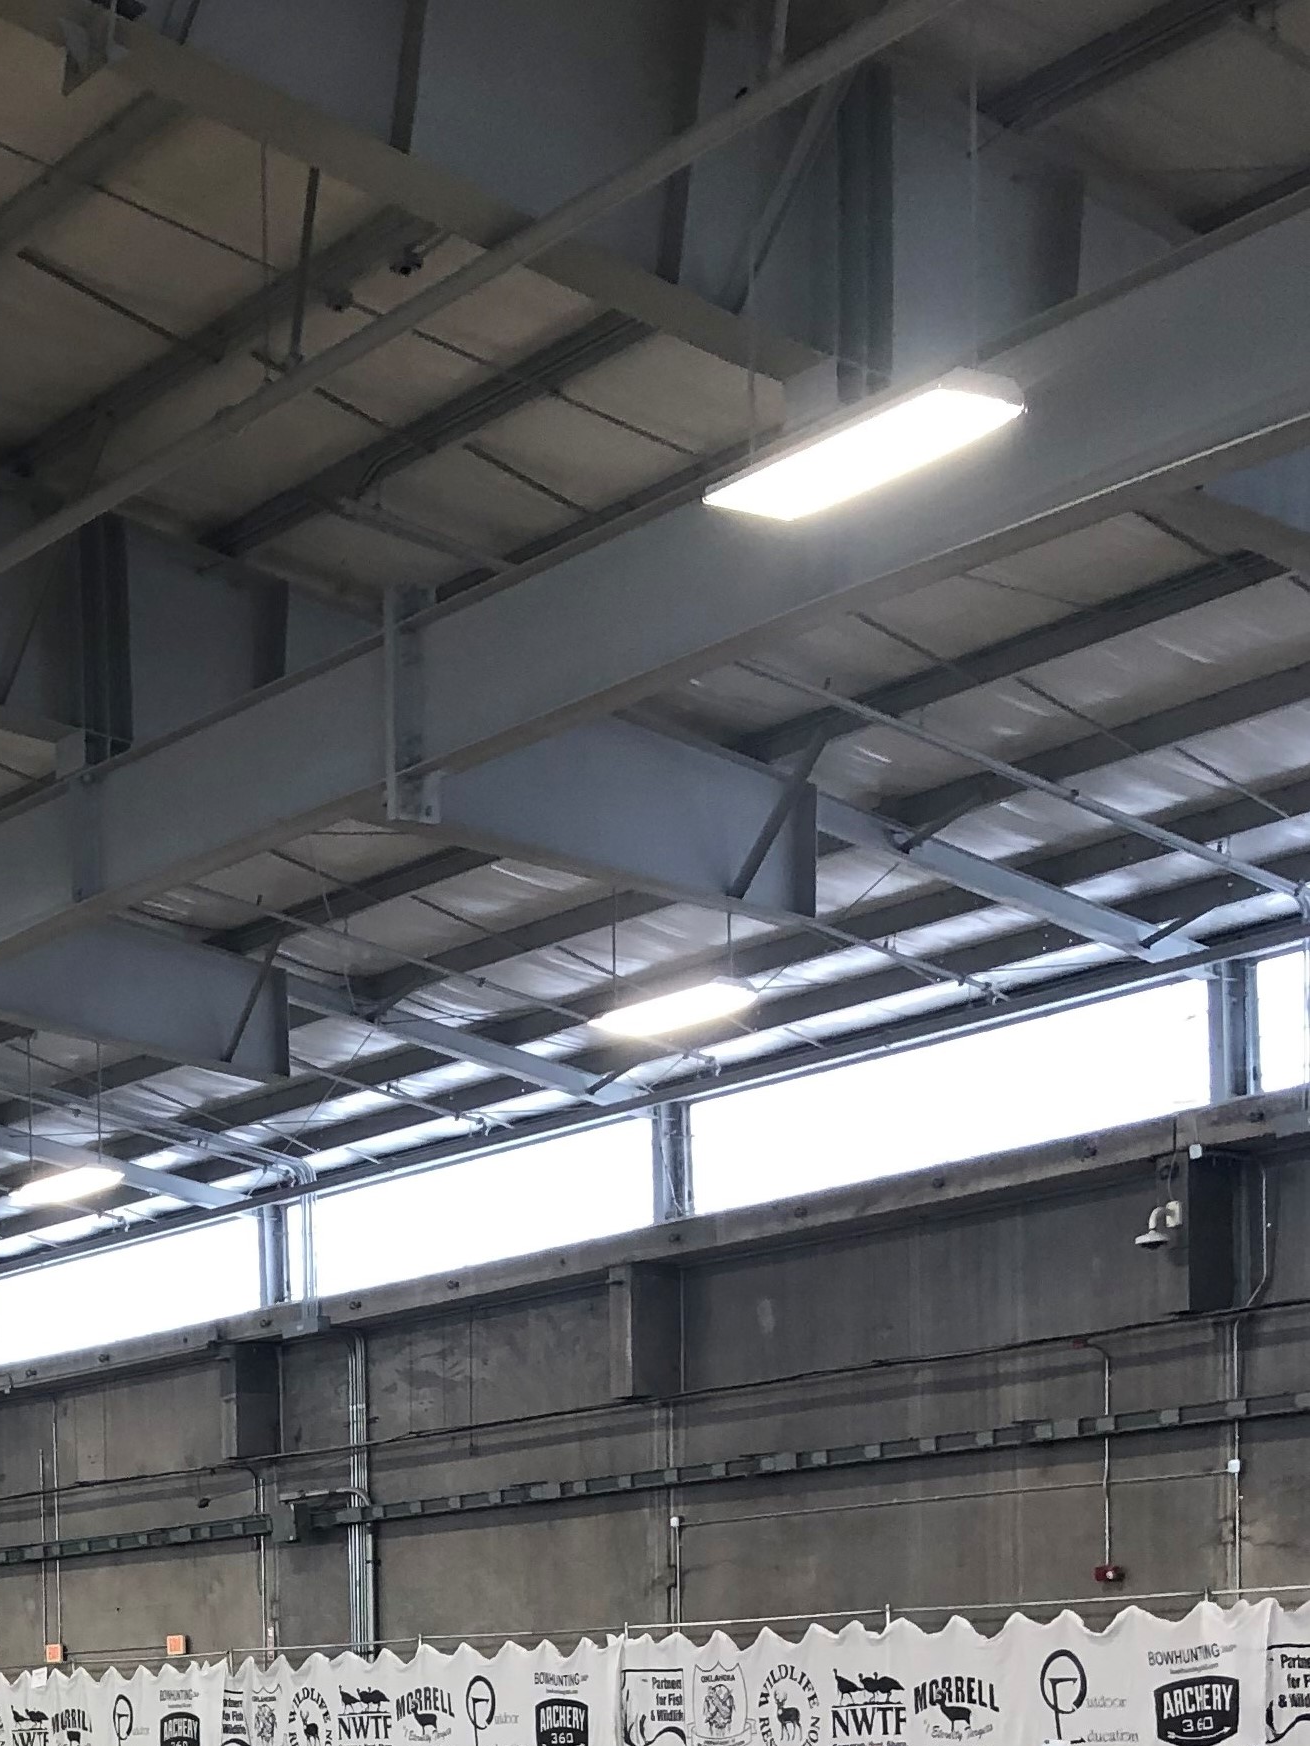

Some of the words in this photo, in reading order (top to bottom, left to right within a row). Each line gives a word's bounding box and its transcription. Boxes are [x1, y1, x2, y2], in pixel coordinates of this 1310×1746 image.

[1148, 1643, 1220, 1666] BOWHUNTING
[758, 1664, 820, 1709] WILDLIFE
[913, 1676, 1000, 1714] MORRELL
[1163, 1684, 1233, 1719] ARCHERY
[338, 1715, 392, 1740] NWTF
[540, 1705, 585, 1732] ARCHERY
[831, 1706, 906, 1738] NWTF
[1181, 1716, 1214, 1732] 360
[550, 1733, 574, 1744] 360
